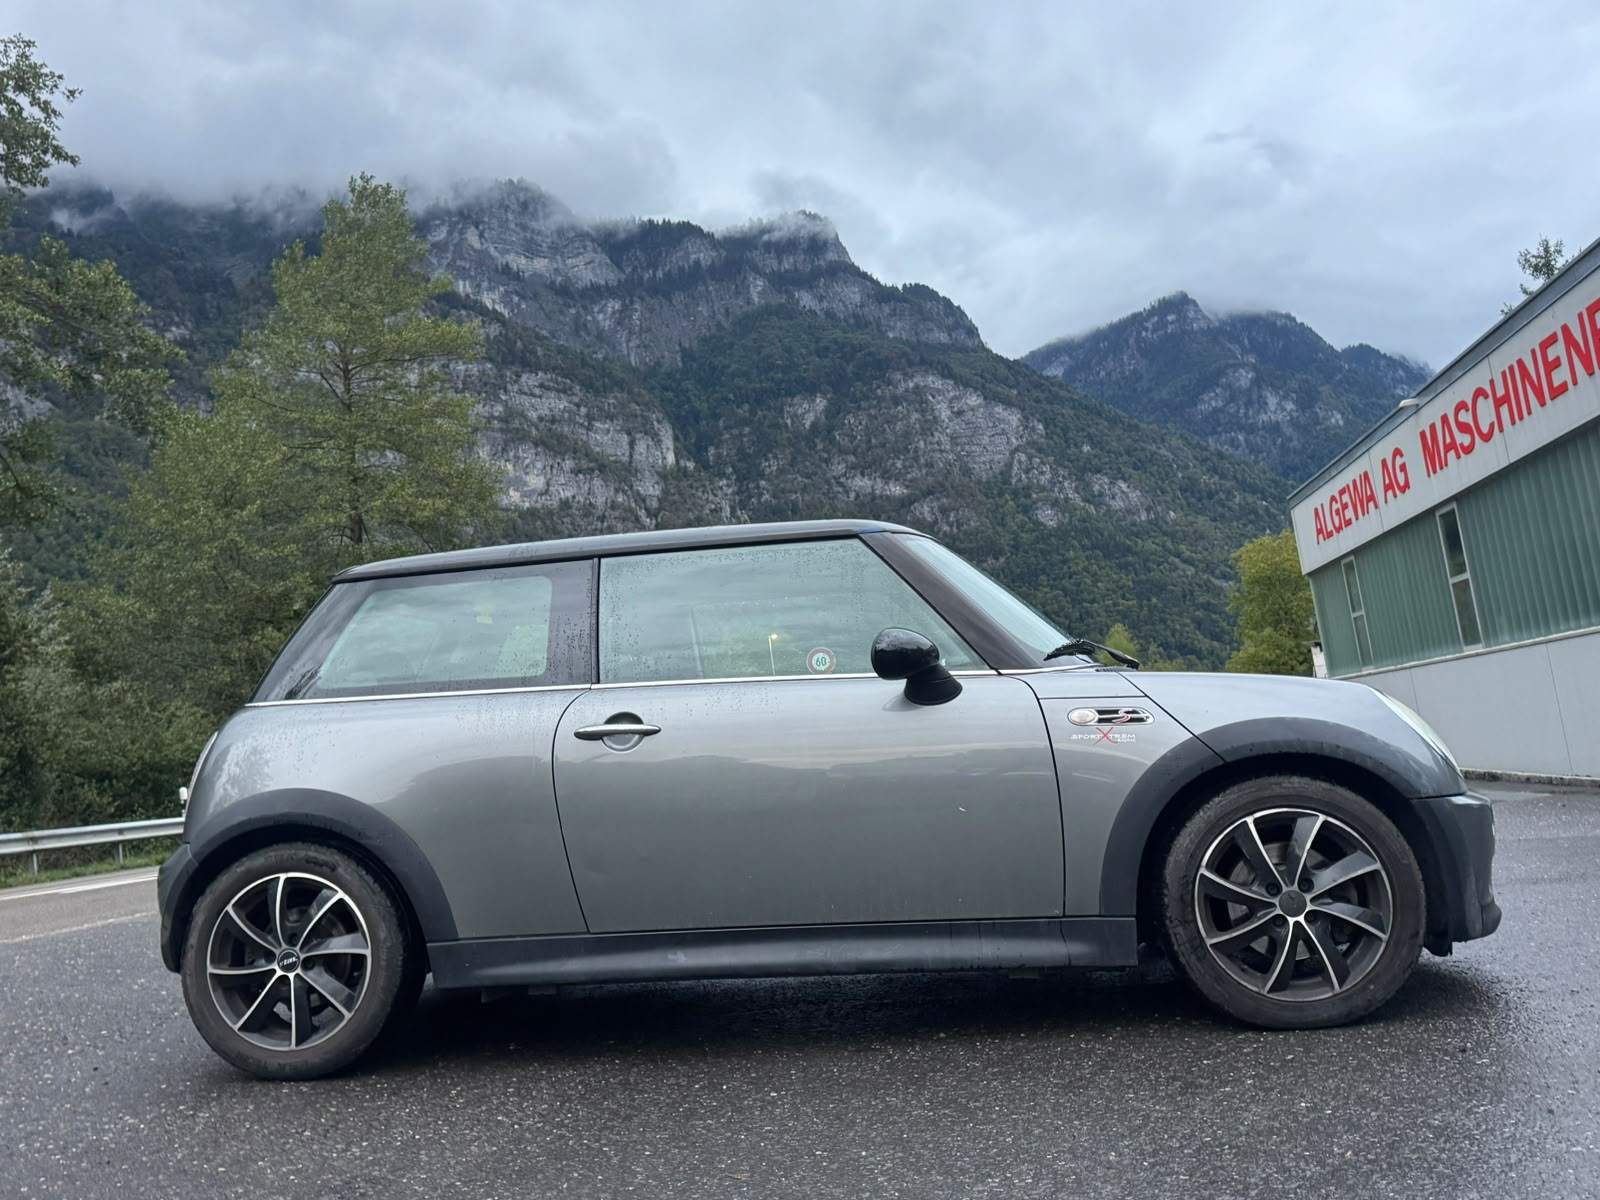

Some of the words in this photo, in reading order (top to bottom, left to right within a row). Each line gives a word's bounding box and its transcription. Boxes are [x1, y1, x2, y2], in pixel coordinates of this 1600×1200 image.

[1314, 470, 1379, 545] ALGEWA
[1381, 447, 1411, 505] AG
[815, 656, 827, 667] 60
[1112, 708, 1131, 724] S
